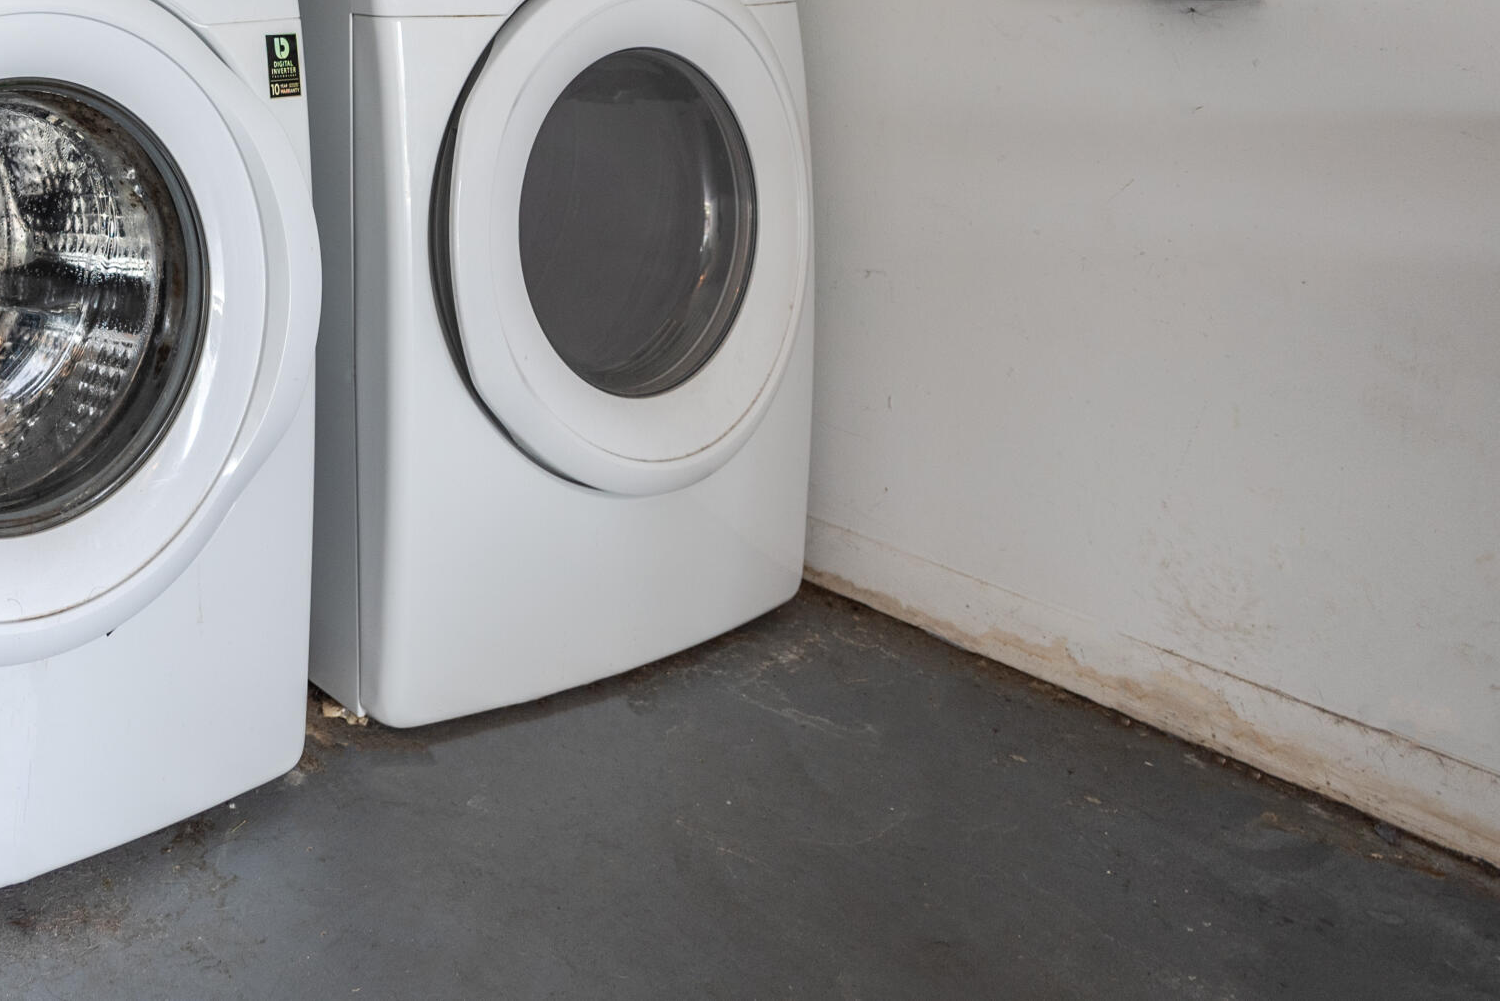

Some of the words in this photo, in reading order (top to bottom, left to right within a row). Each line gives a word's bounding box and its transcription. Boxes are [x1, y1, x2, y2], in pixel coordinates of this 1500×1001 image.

[273, 60, 294, 68] DIGITAL
[271, 67, 296, 75] INVERTER
[271, 83, 280, 96] 10
